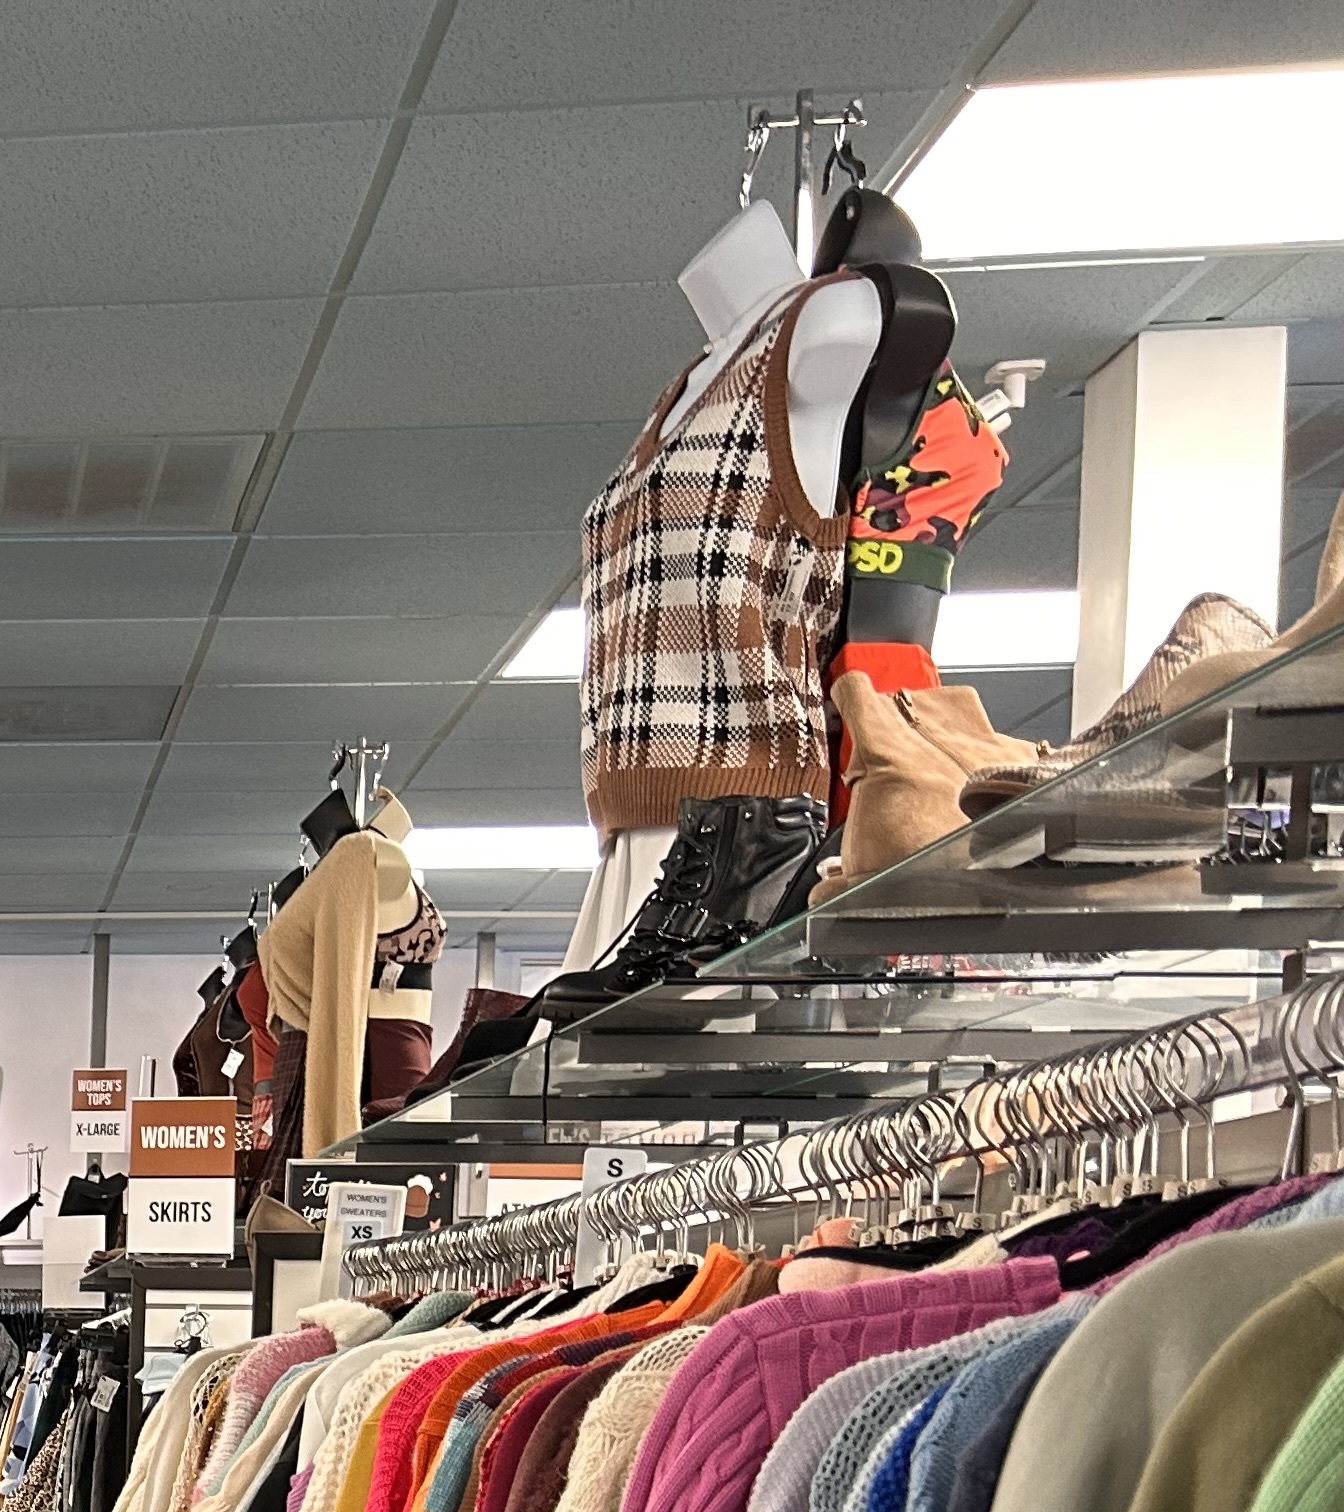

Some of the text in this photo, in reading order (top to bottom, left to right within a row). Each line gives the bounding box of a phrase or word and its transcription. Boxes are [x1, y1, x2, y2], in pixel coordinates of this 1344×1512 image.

[77, 1079, 122, 1093] WOMEN'S
[87, 1093, 112, 1106] TOPS
[76, 1122, 121, 1137] X-LARGE
[140, 1125, 226, 1149] WOMEN'S
[606, 1158, 624, 1178] S
[347, 1193, 387, 1204] WOMEN'S
[148, 1201, 212, 1223] SKIRTS
[340, 1208, 387, 1218] SWEATERS
[351, 1225, 373, 1239] XS
